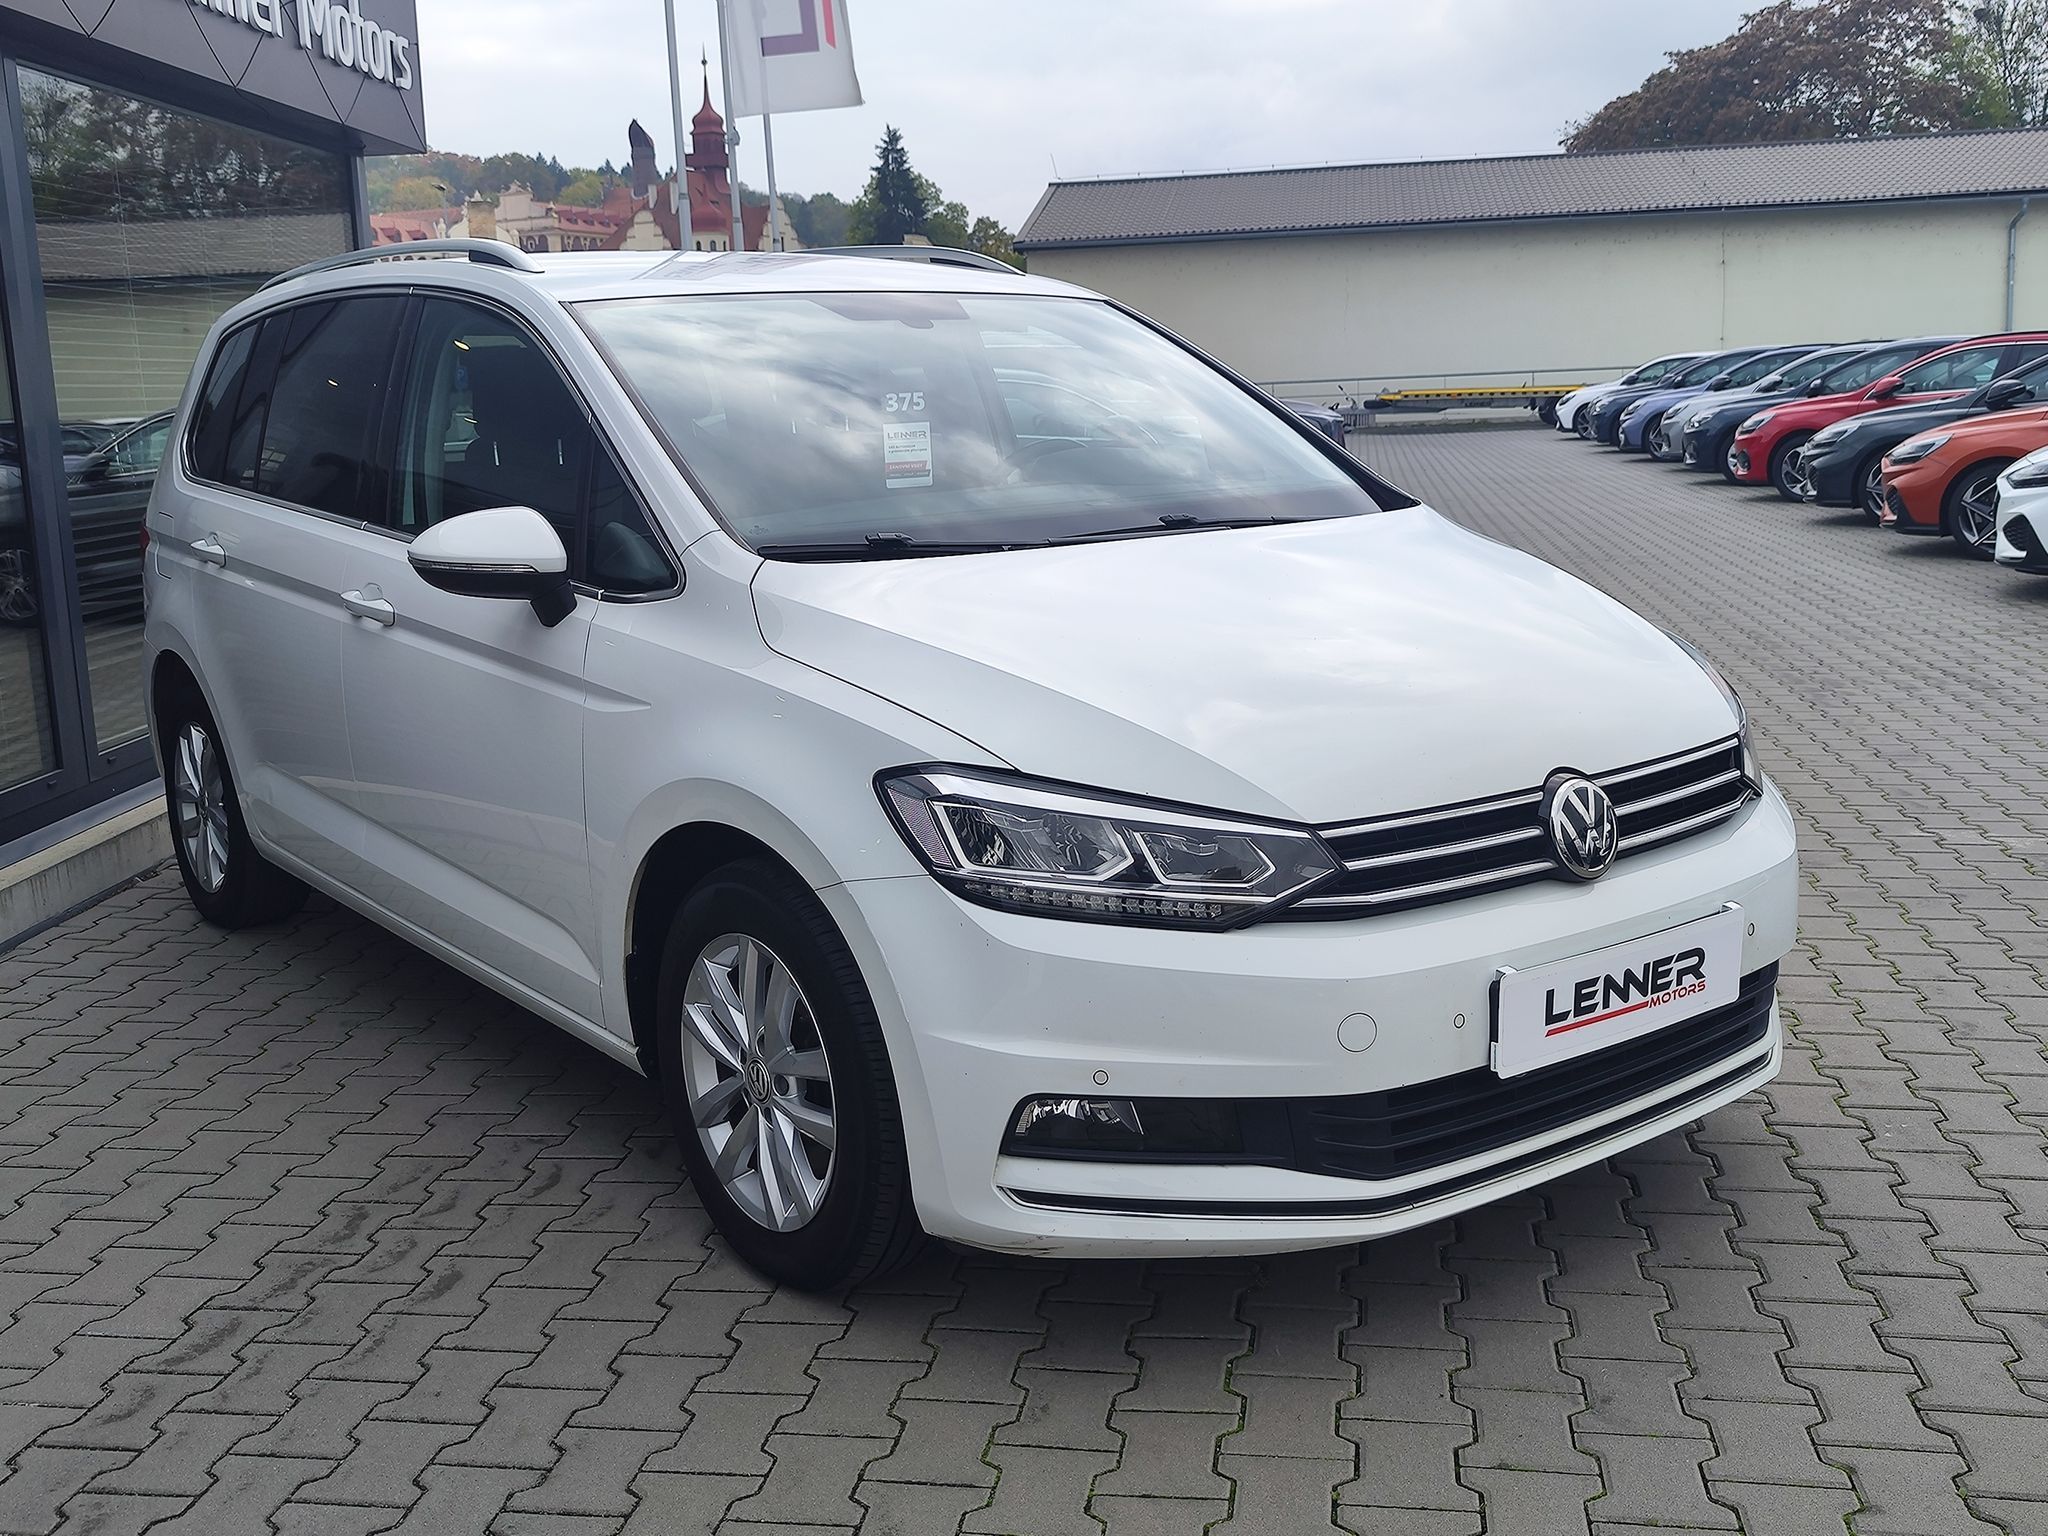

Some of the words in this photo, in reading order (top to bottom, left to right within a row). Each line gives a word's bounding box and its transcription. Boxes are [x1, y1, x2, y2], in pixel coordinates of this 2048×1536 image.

[297, 0, 413, 90] Motors
[886, 392, 925, 412] 375
[887, 430, 927, 440] LENNER
[1545, 947, 1706, 1026] LENNER
[1649, 979, 1706, 1009] MOTORS
